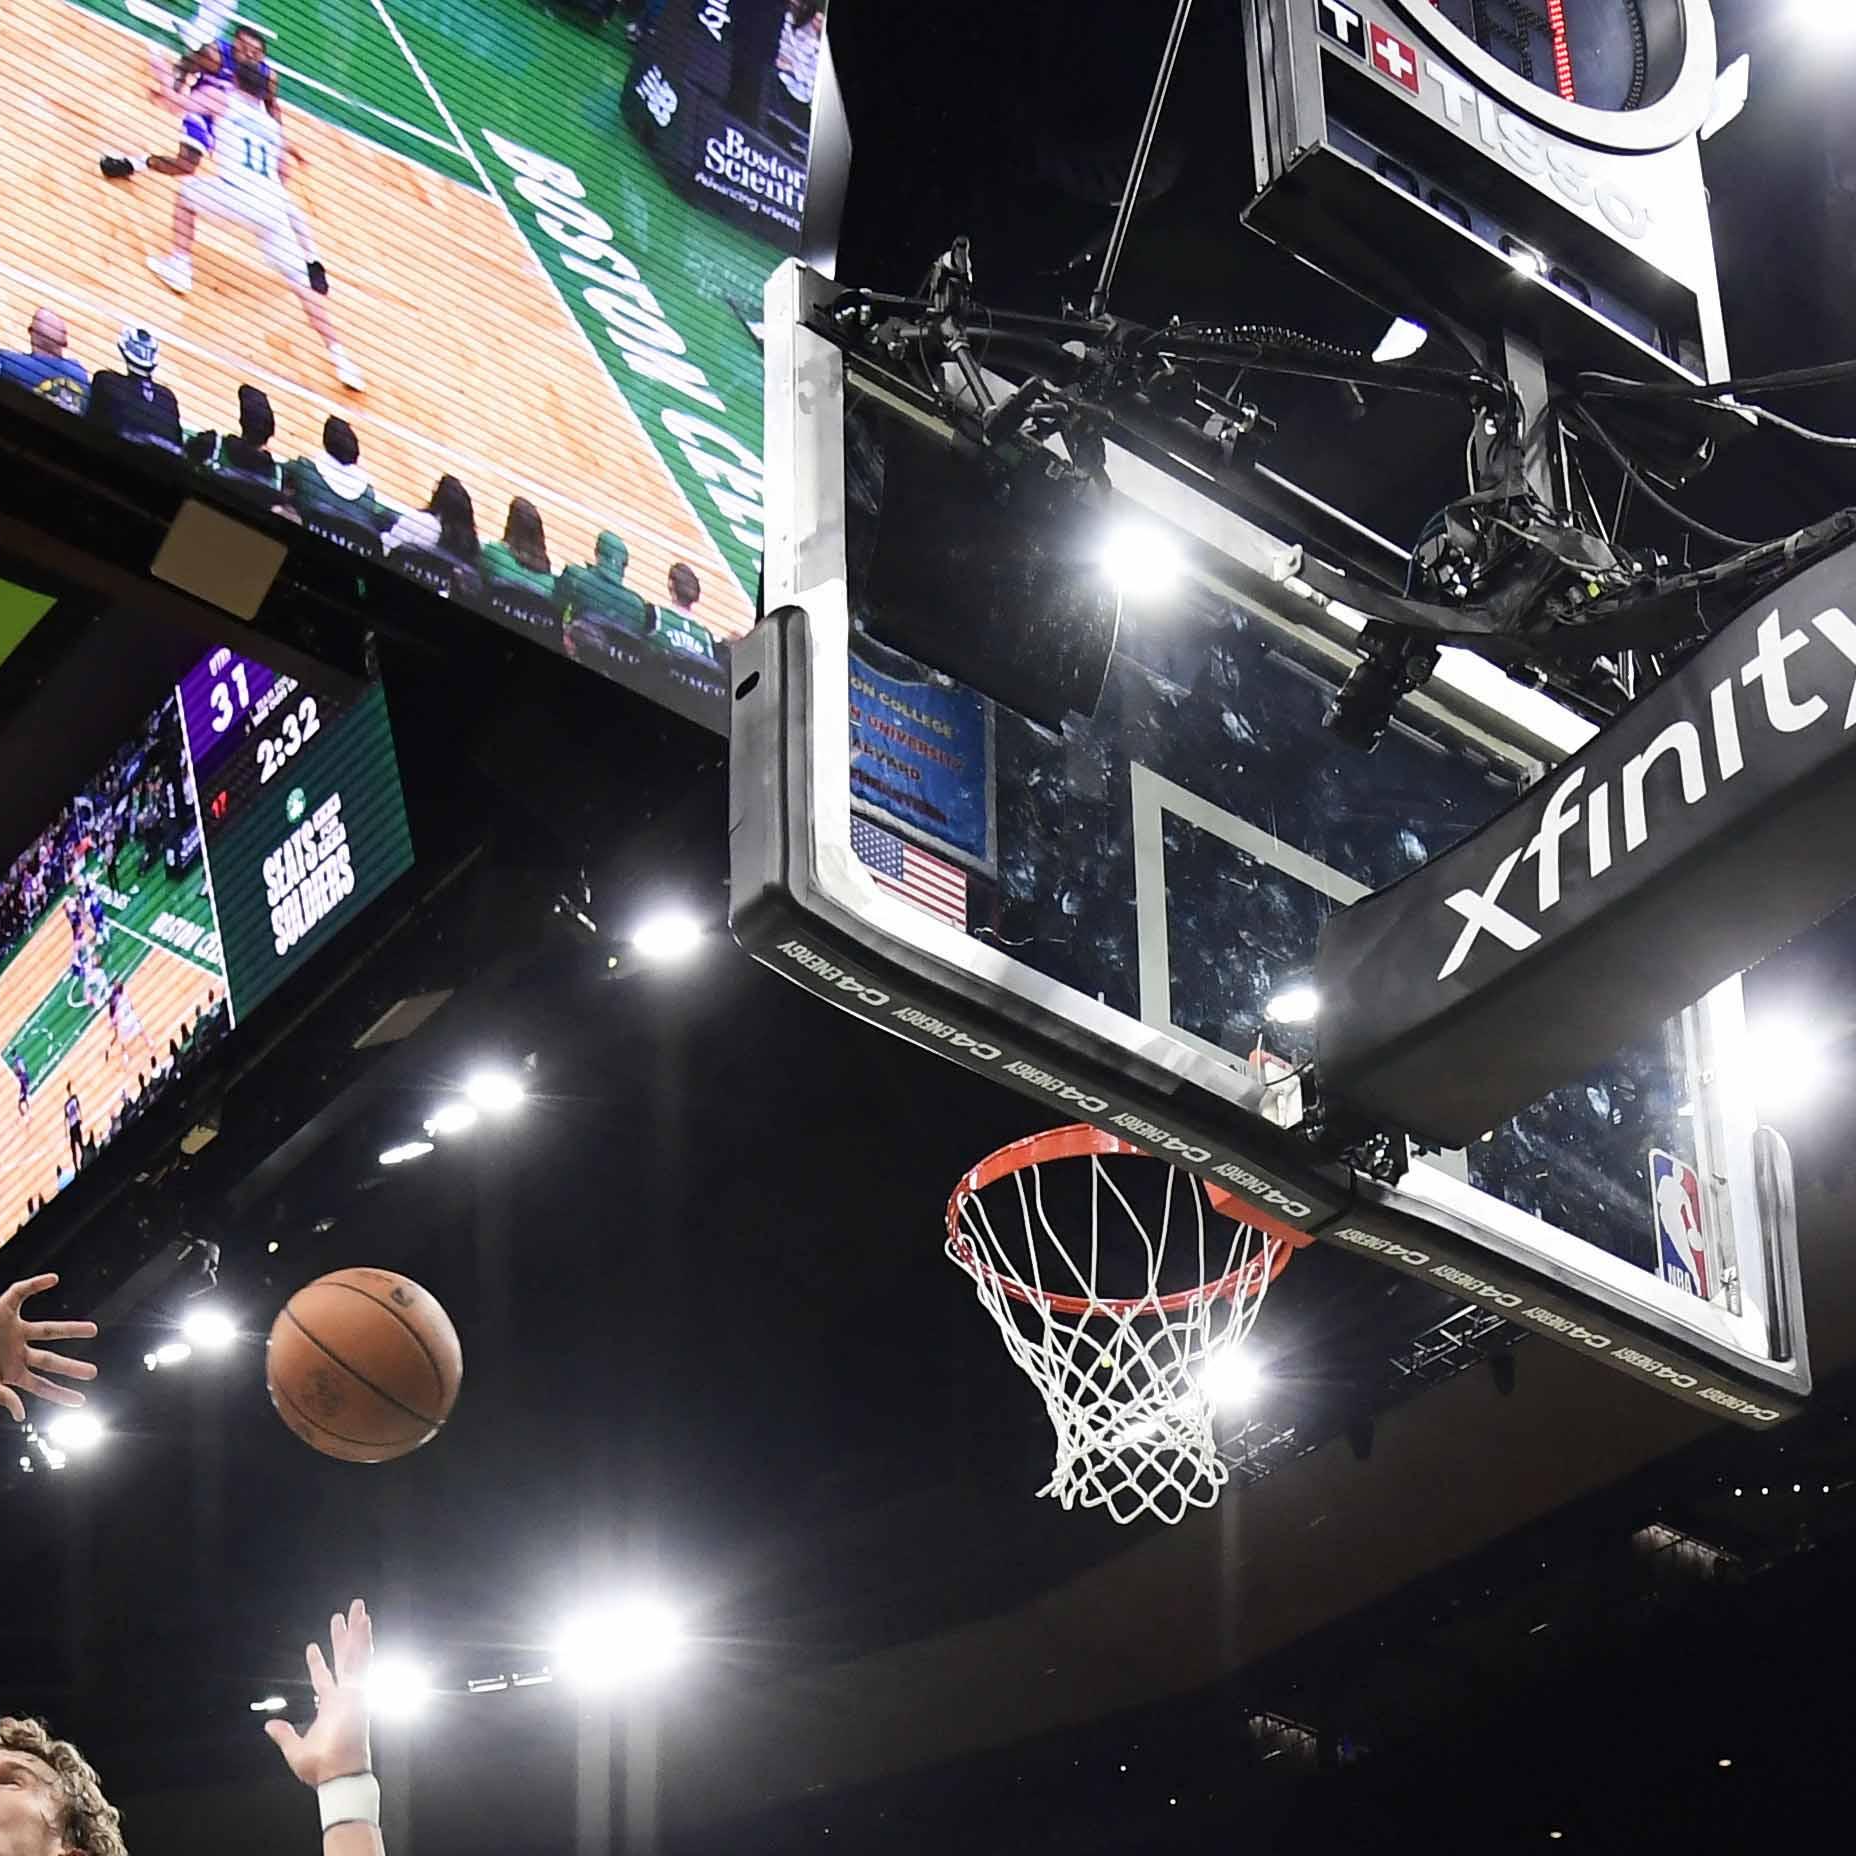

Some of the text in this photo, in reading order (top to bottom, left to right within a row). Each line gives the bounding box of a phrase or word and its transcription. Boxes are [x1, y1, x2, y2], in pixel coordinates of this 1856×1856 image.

[242, 137, 270, 178] 11
[481, 128, 727, 413] BOSTON
[210, 662, 249, 732] 31
[257, 696, 320, 784] 2:32
[263, 820, 318, 907] SEATS
[270, 843, 355, 956] SOLDIERS
[776, 940, 843, 981] ENERGY
[890, 1007, 957, 1039] ENERGY
[1001, 1060, 1065, 1093] ENERGY
[1108, 1112, 1213, 1163] C4 ENERGY
[1211, 1162, 1312, 1218] C4 ENERGY
[1333, 1228, 1431, 1266] C4 ENERGY
[1666, 1262, 1693, 1296] NBA
